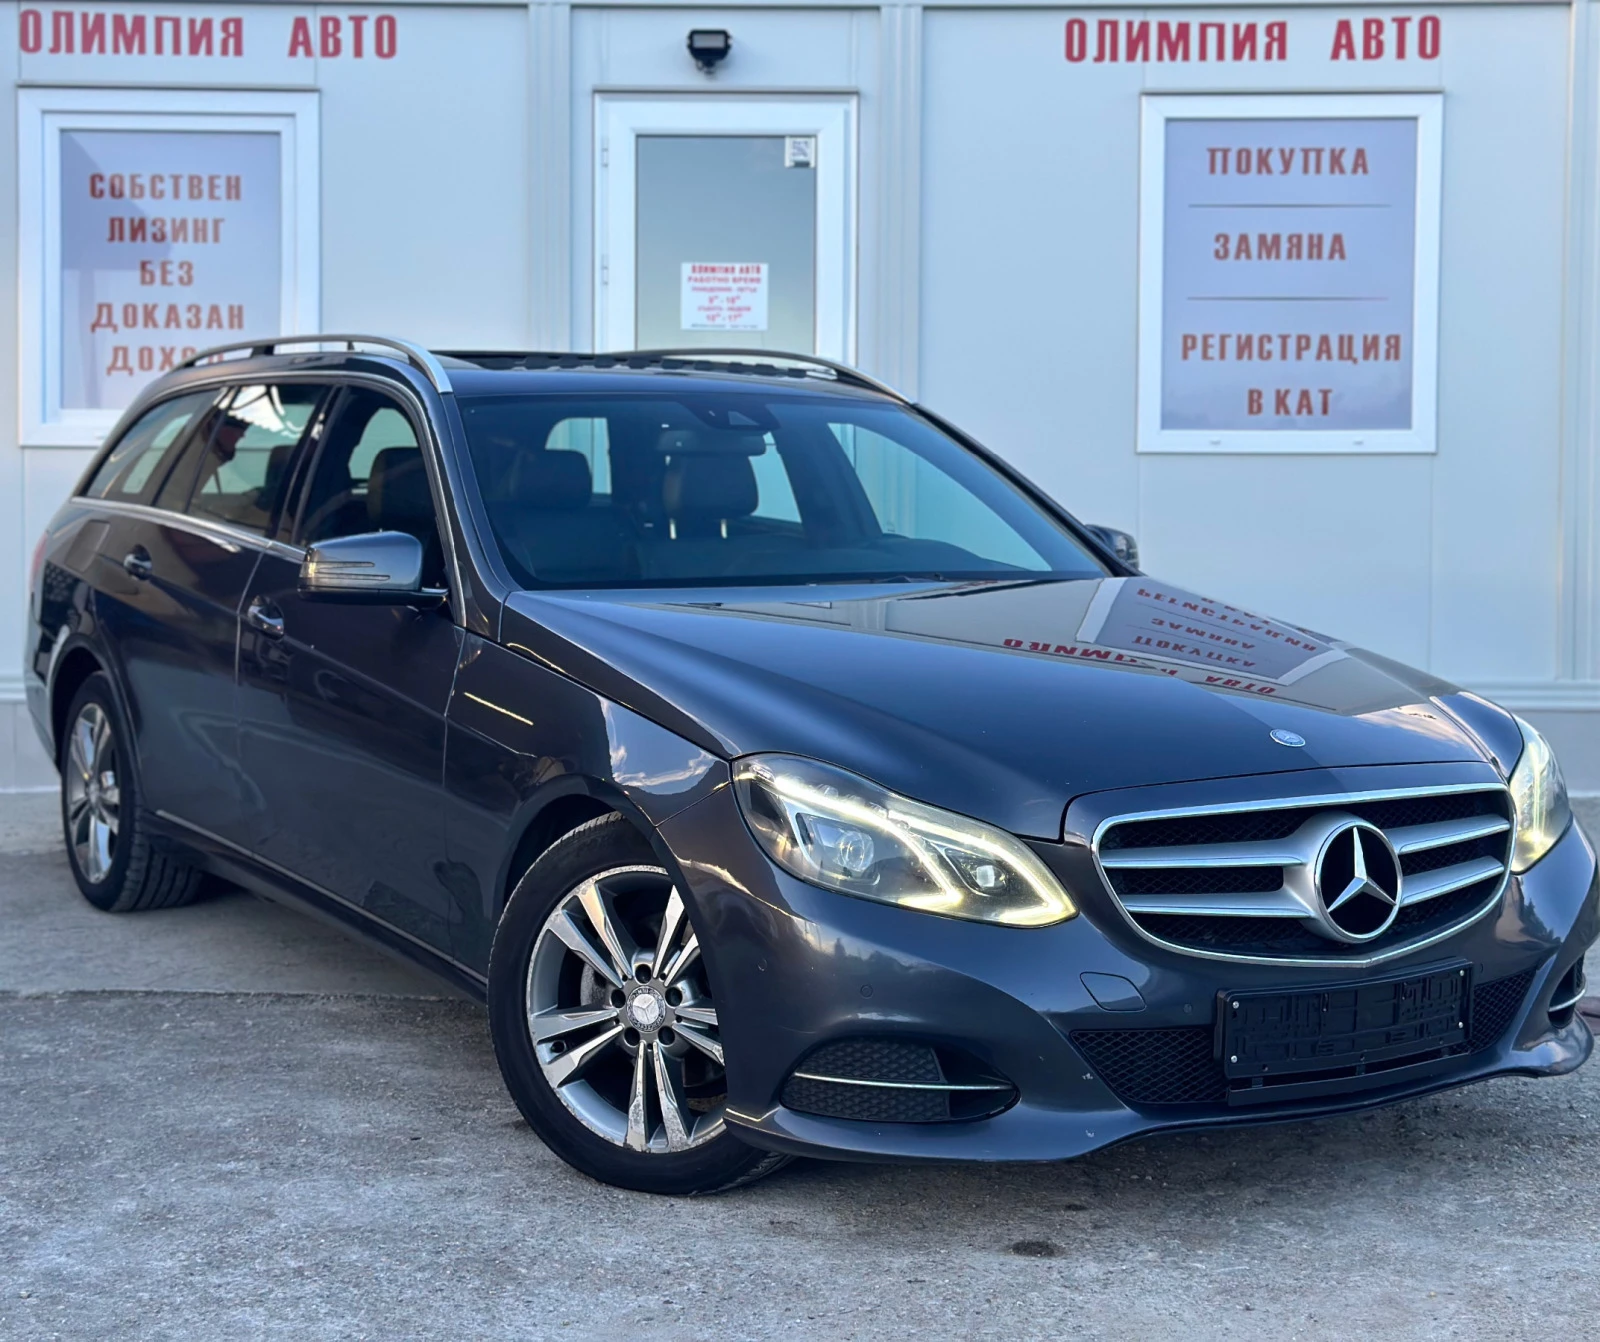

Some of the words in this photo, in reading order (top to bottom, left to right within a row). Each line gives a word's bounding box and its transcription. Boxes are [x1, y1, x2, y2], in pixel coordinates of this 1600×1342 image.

[19, 9, 244, 57] ОЛИМПИЯ
[287, 14, 398, 60] АВТО
[1064, 18, 1288, 63] ОЛИМПИЯ
[1330, 15, 1442, 61] АВТО
[1207, 147, 1369, 176] ПОКУПКА
[89, 173, 242, 201] СОБСТВЕН
[107, 217, 226, 244] ЛИЗИНГ
[1213, 233, 1347, 261] ЗАМЯНА
[139, 260, 195, 287] БЕЗ
[90, 303, 245, 333] ДОКАЗАН
[1181, 334, 1402, 364] РЕГИСТРАЦИЯ
[1247, 388, 1264, 417] В
[1274, 388, 1334, 417] КАТ
